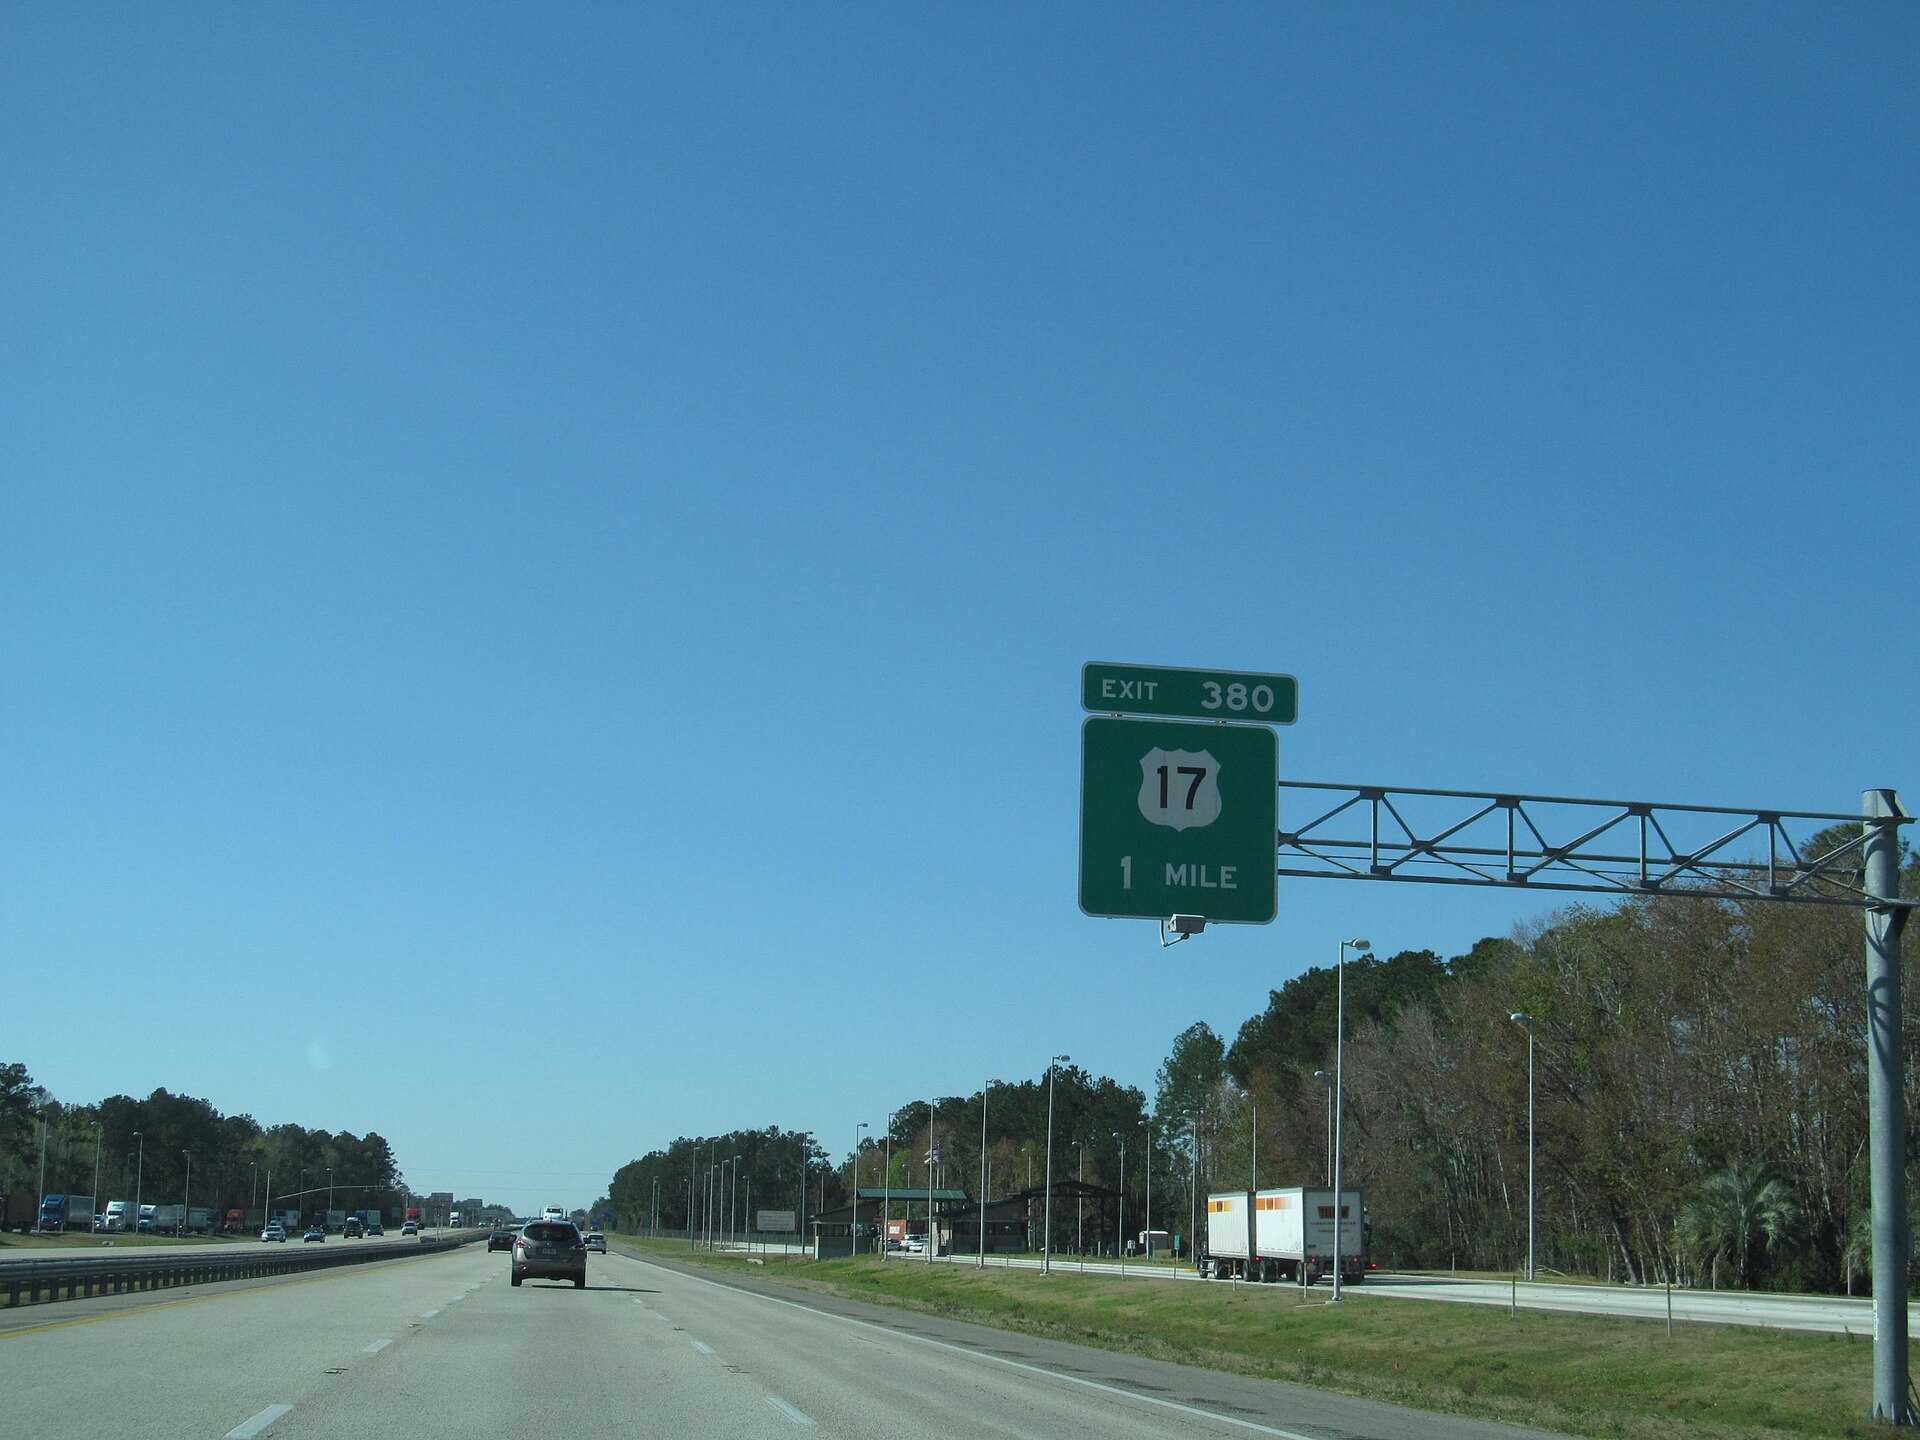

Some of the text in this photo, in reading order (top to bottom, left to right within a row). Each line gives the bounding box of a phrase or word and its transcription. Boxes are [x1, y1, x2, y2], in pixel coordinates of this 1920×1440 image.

[1101, 678, 1275, 713] EXIT 380
[1156, 765, 1207, 810] 17
[1120, 856, 1238, 890] 1 MILE
